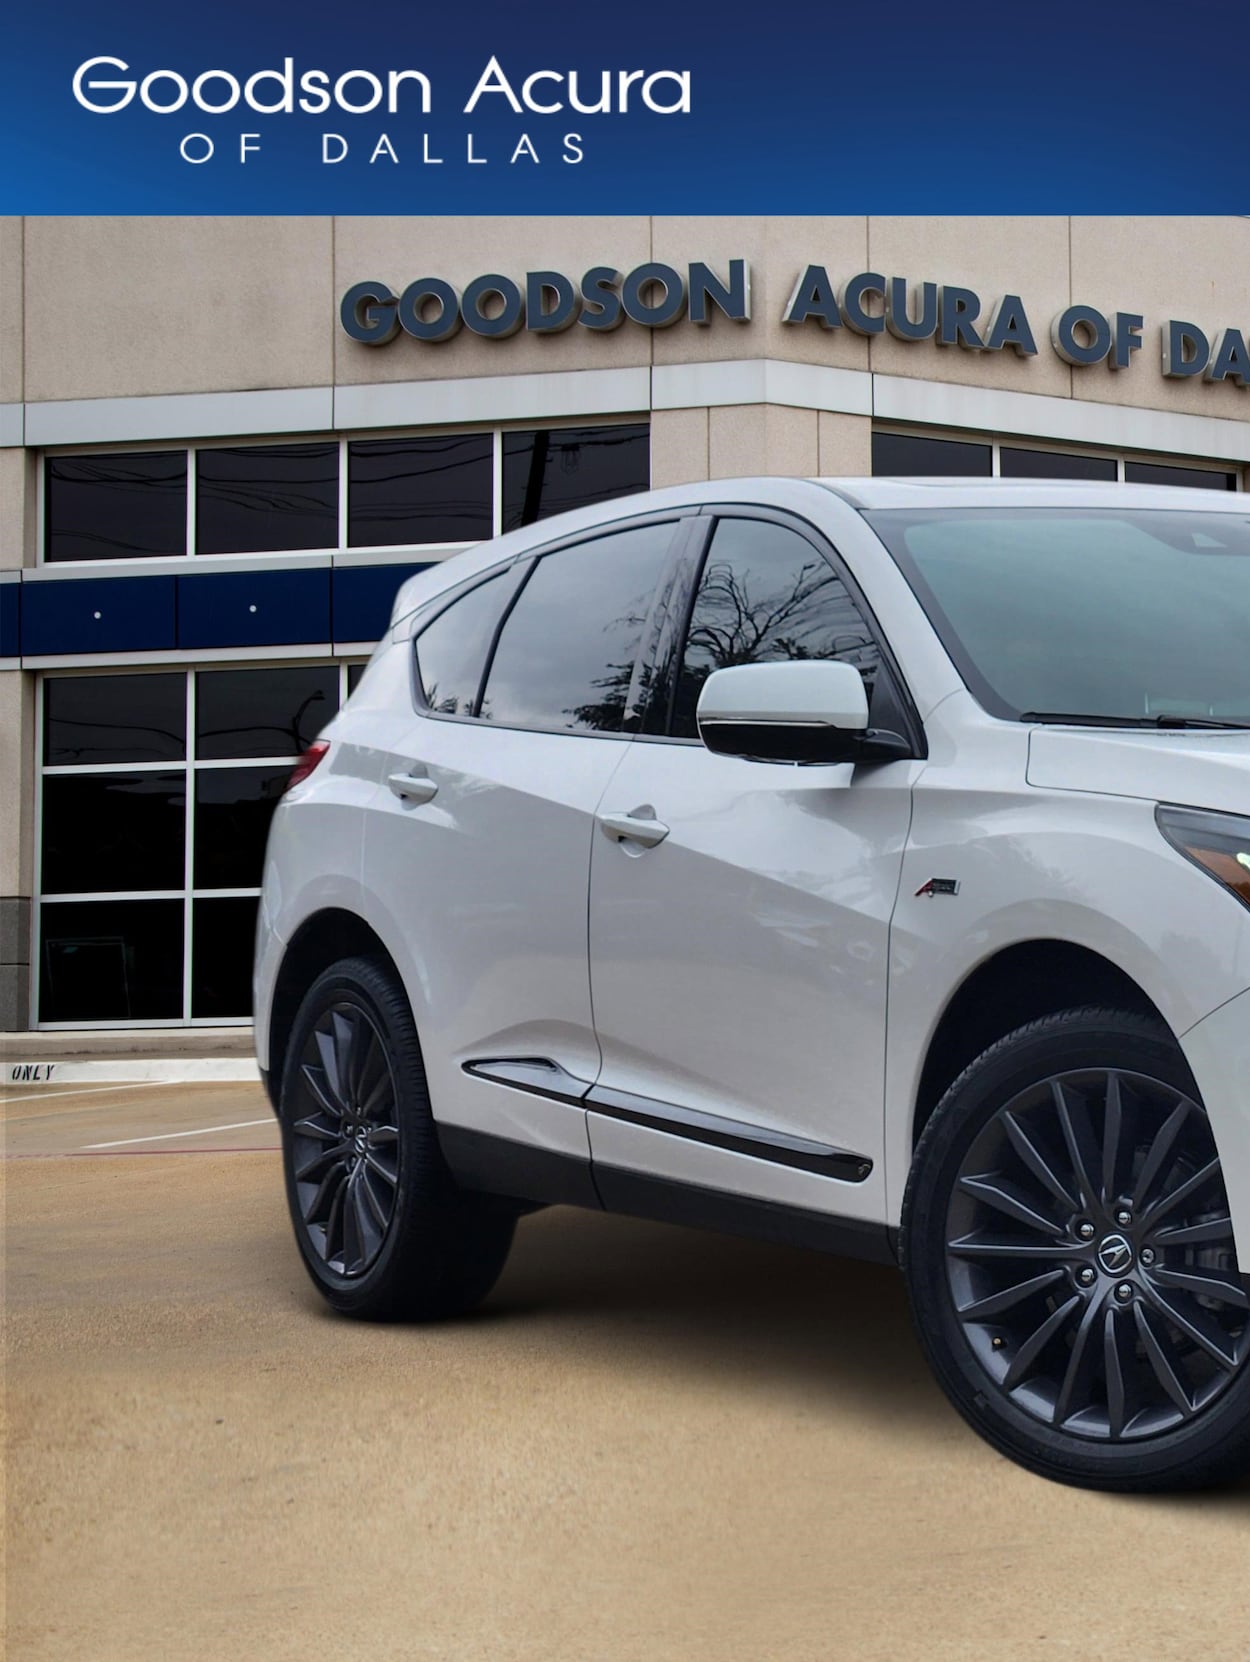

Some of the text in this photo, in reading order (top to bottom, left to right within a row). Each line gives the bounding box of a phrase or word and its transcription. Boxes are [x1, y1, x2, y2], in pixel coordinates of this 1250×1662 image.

[340, 259, 751, 346] GOODSON
[782, 264, 1038, 357] ACURA
[1051, 304, 1143, 369] OF
[12, 1064, 54, 1081] ONLY
